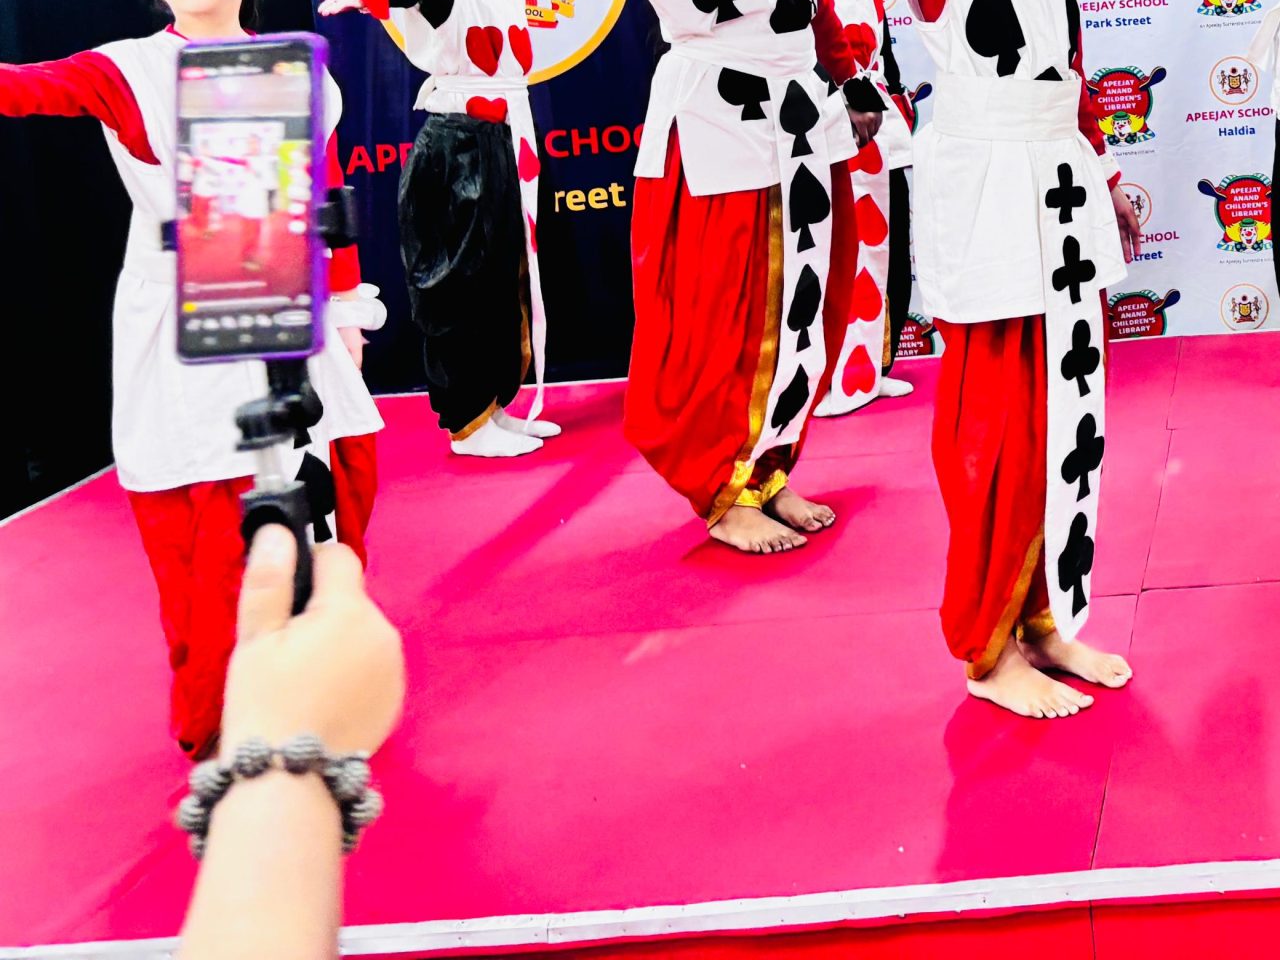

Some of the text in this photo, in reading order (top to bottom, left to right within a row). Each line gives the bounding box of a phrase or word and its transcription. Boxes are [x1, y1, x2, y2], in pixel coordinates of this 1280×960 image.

[1080, 1, 1116, 12] EEJAY
[1085, 16, 1151, 29] Park Street
[1097, 94, 1142, 103] CHILDREN'S
[1185, 110, 1235, 122] APEEJAY
[1218, 125, 1256, 136] Haldia
[1230, 186, 1261, 194] APEEJAY
[555, 182, 627, 212] reet
[1225, 201, 1268, 210] CHILDREN'S
[1231, 209, 1263, 217] LIBRARY
[1117, 302, 1149, 312] APEEJAY
[1121, 310, 1147, 319] ANAND
[1119, 325, 1150, 334] LIBRARY
